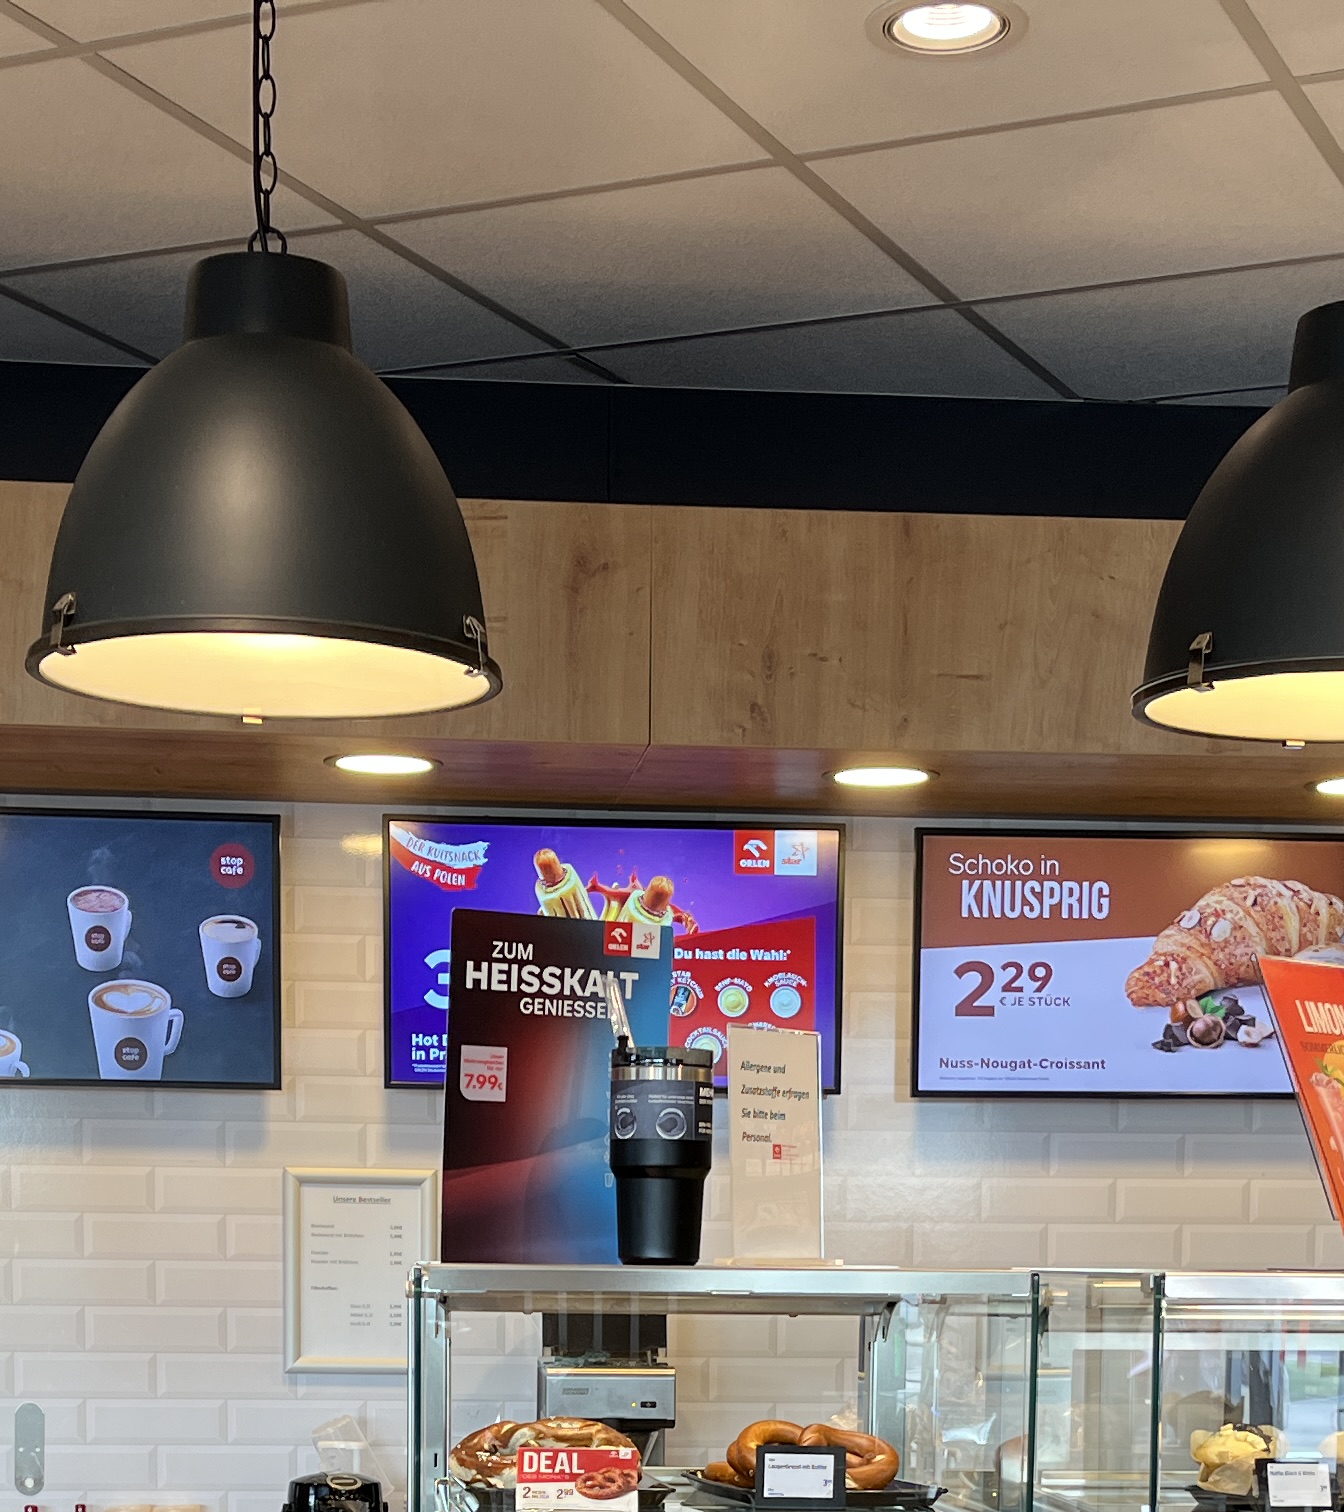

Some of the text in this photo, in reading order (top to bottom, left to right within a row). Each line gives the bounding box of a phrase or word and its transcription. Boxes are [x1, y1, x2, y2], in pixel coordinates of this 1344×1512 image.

[406, 837, 425, 853] DER
[220, 856, 244, 867] stop
[739, 858, 770, 868] ORLEN
[948, 853, 1060, 876] Schoko in
[220, 865, 244, 875] cafe
[411, 861, 466, 886] AUS POLEN
[961, 879, 1110, 920] KNUSPRIG
[492, 941, 534, 960] ZUM
[674, 948, 692, 959] Du
[695, 949, 724, 960] hast
[726, 948, 748, 960] die
[1010, 994, 1071, 1007] JE STÜCK
[411, 1033, 439, 1047] Hot
[411, 1048, 425, 1060] in
[740, 1060, 786, 1074] Allergene und
[939, 1057, 1106, 1072] Nuss-Nougat-Croissant
[741, 1084, 809, 1101] Zusatzstoffe erfragen
[741, 1108, 751, 1118] Sie
[770, 1109, 786, 1120] beim
[523, 1451, 585, 1474] DEAL
